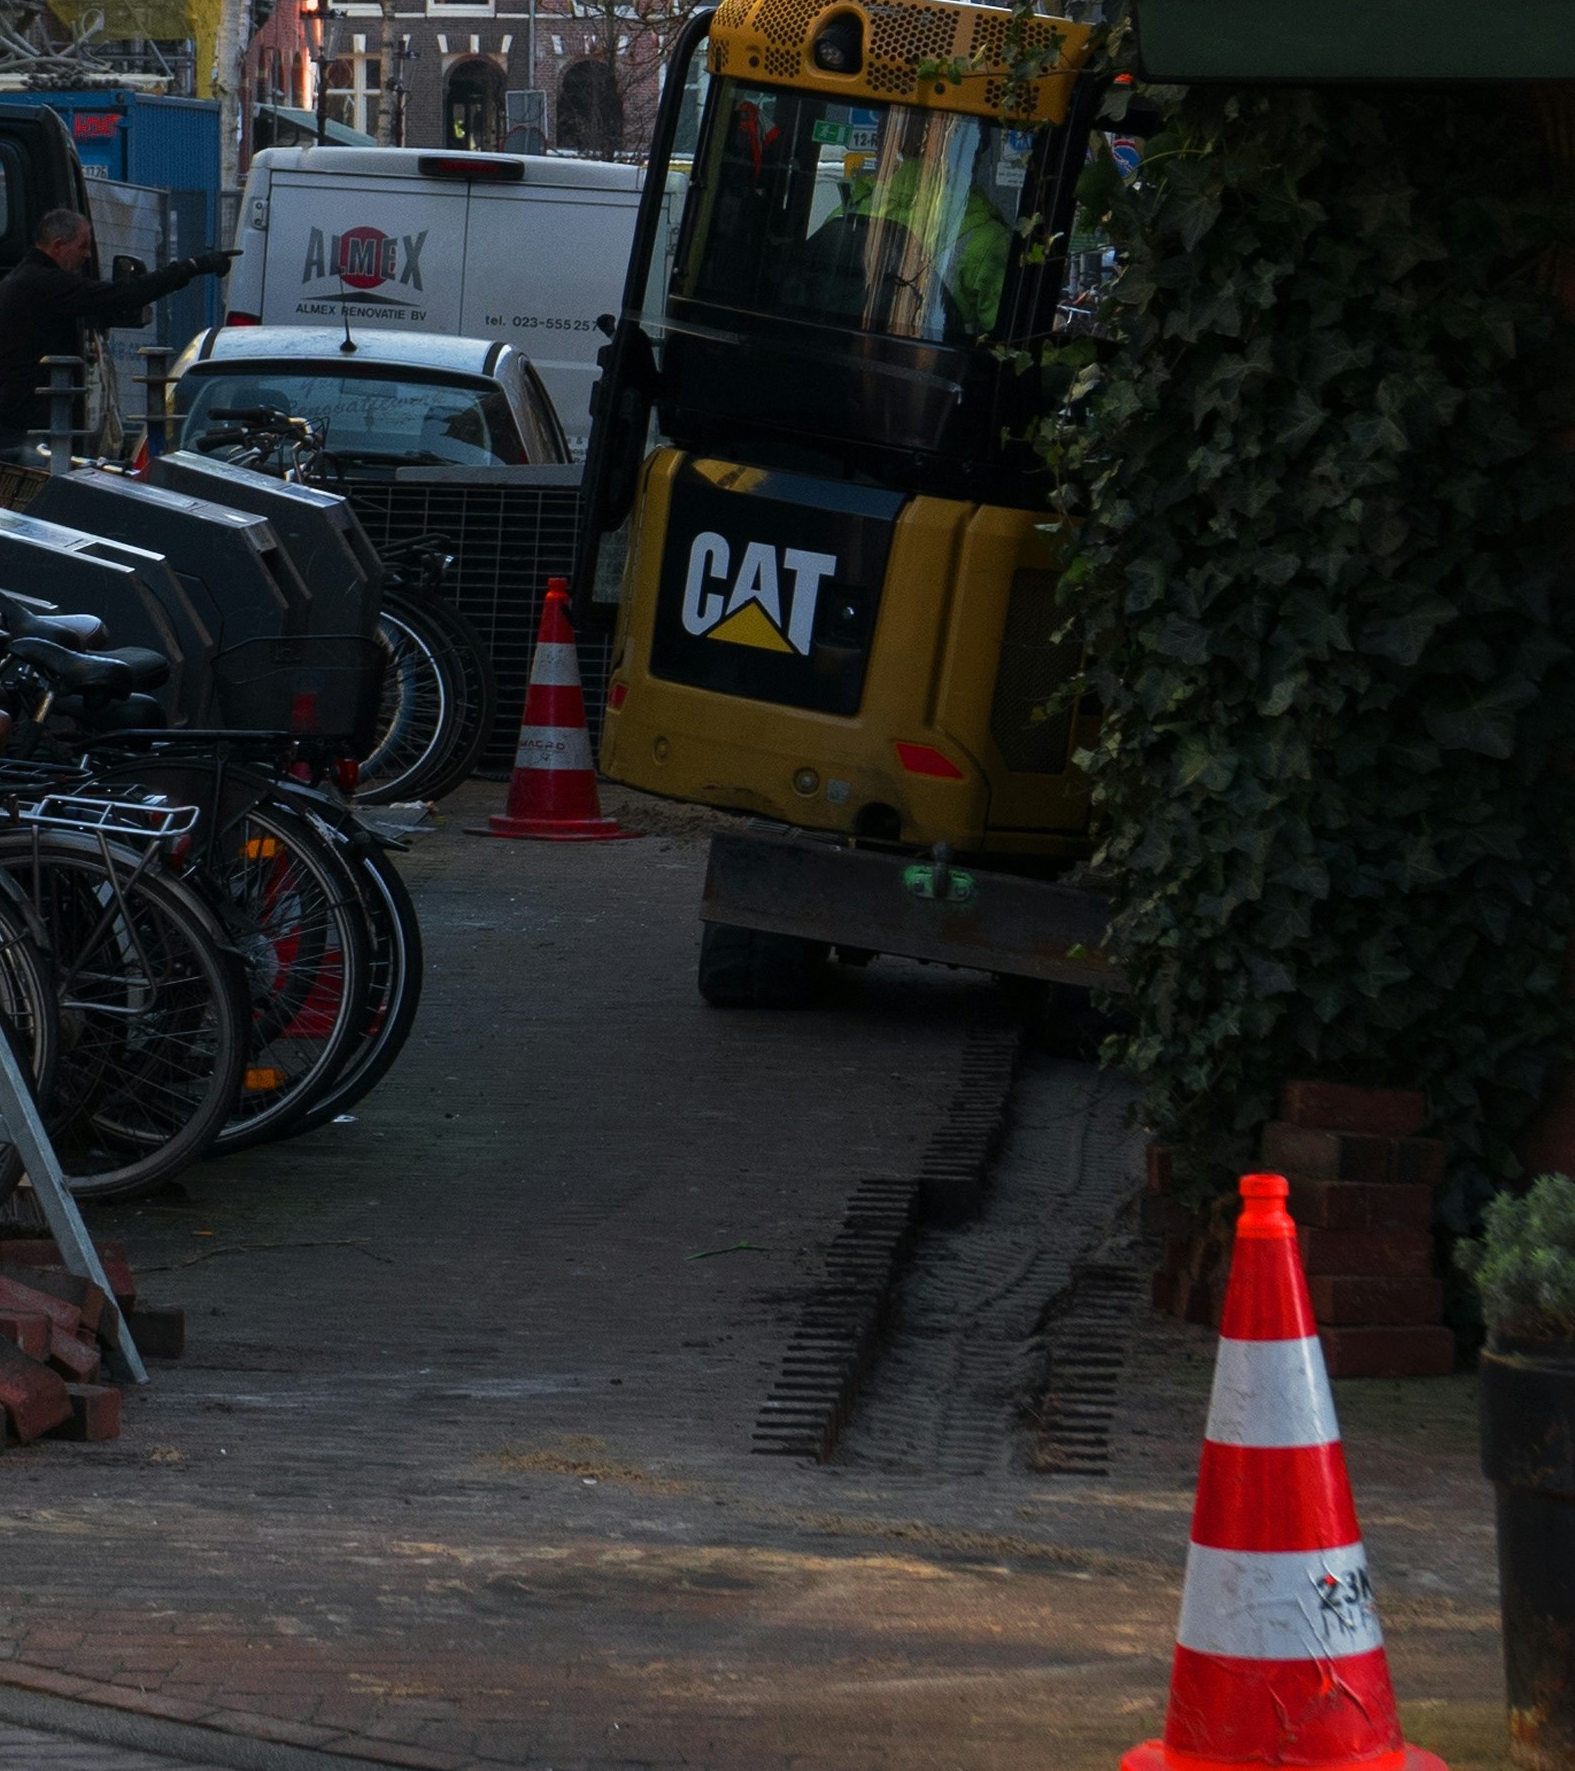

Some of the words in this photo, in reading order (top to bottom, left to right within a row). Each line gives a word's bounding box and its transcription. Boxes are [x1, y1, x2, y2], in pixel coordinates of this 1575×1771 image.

[301, 225, 429, 292] ALMEX
[296, 303, 336, 316] ALMEX
[341, 305, 406, 320] RENOVATIE
[411, 310, 427, 322] BV
[485, 315, 507, 327] tel.
[681, 531, 837, 656] CAT
